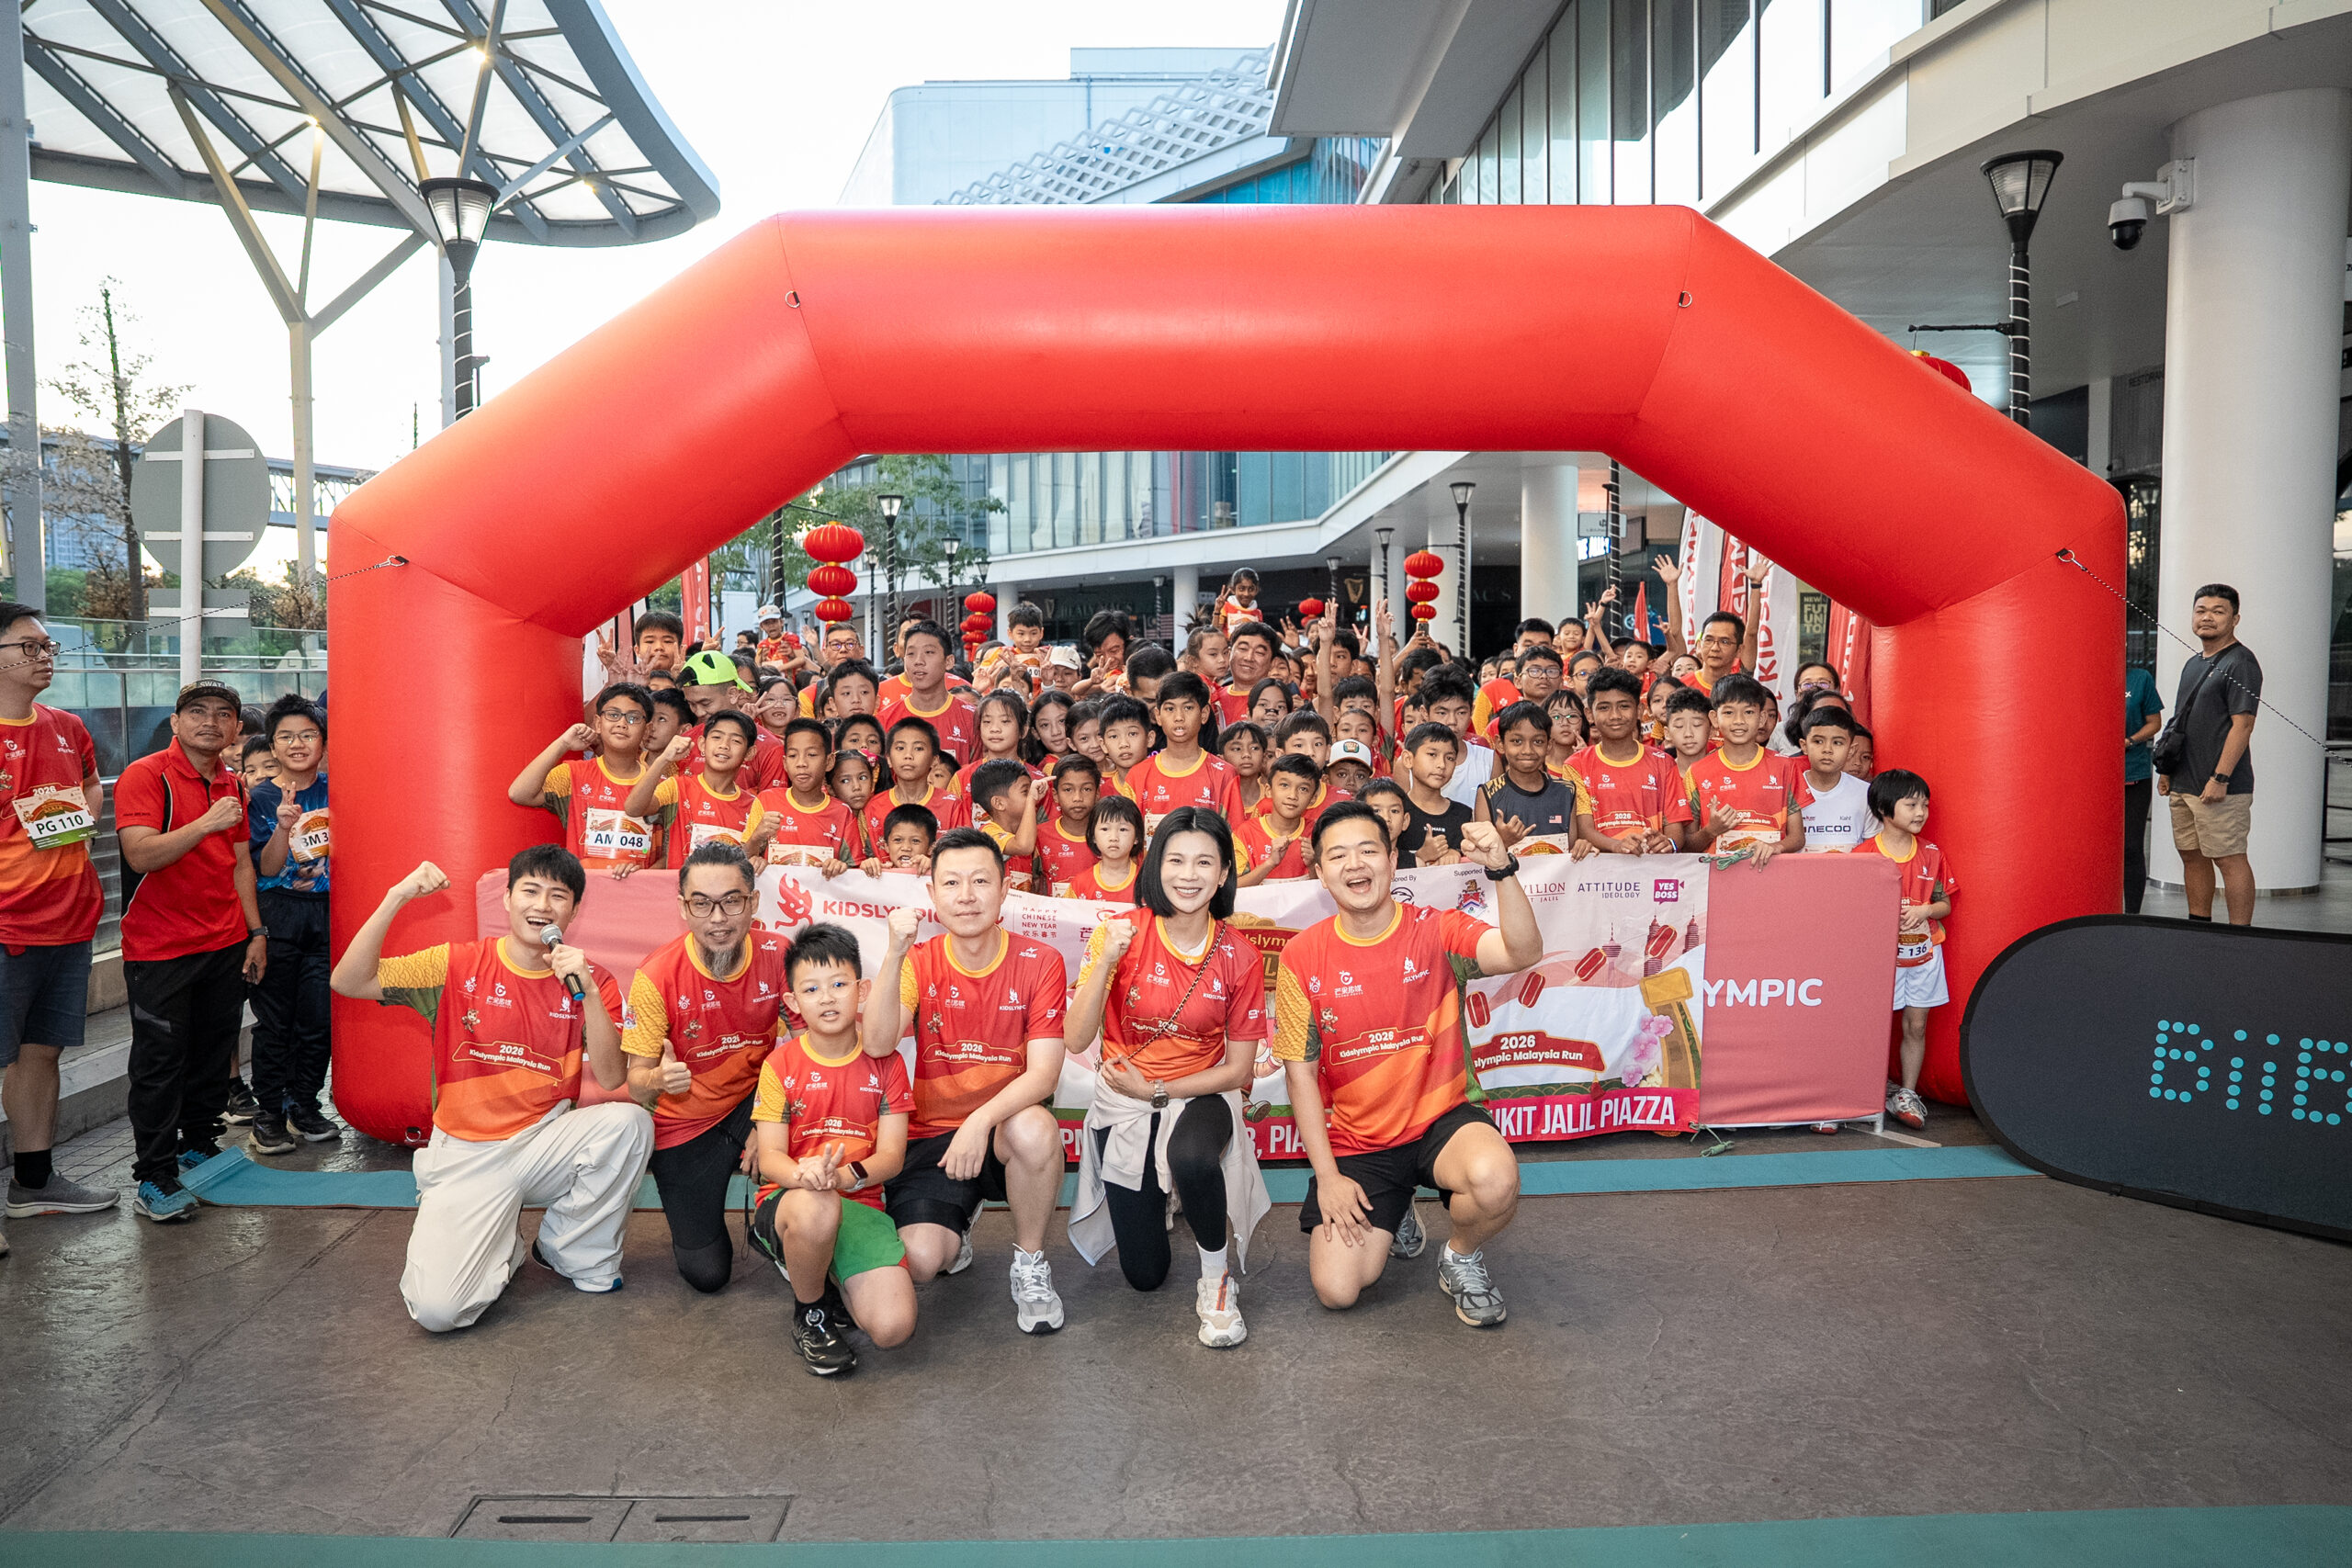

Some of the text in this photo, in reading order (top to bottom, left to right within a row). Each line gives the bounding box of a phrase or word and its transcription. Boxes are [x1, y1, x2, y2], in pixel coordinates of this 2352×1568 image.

[36, 814, 84, 835] PG 110
[620, 835, 643, 848] 048
[1408, 874, 1418, 883] By
[1453, 868, 1483, 877] Supported
[1577, 882, 1641, 893] ATTITUDE
[1657, 882, 1675, 890] YES
[1654, 890, 1678, 899] BOSS
[1022, 913, 1057, 921] CHINESE
[1908, 943, 1928, 957] 136
[1403, 969, 1430, 984] SLYMPIC
[1368, 1031, 1394, 1043] 2026
[1499, 1035, 1536, 1050] 2026
[499, 1044, 525, 1056] 2026
[961, 1043, 983, 1054] 2026
[1339, 1043, 1380, 1058] Kidslympic
[469, 1049, 551, 1071] Kidslympic Malaysia Run
[934, 1049, 1012, 1063] Kidslympic Malaysia Run
[1513, 1049, 1560, 1062] Malaysia
[1561, 1050, 1583, 1061] Run
[1489, 1096, 1676, 1137] UKIT JALIL PIAZZA
